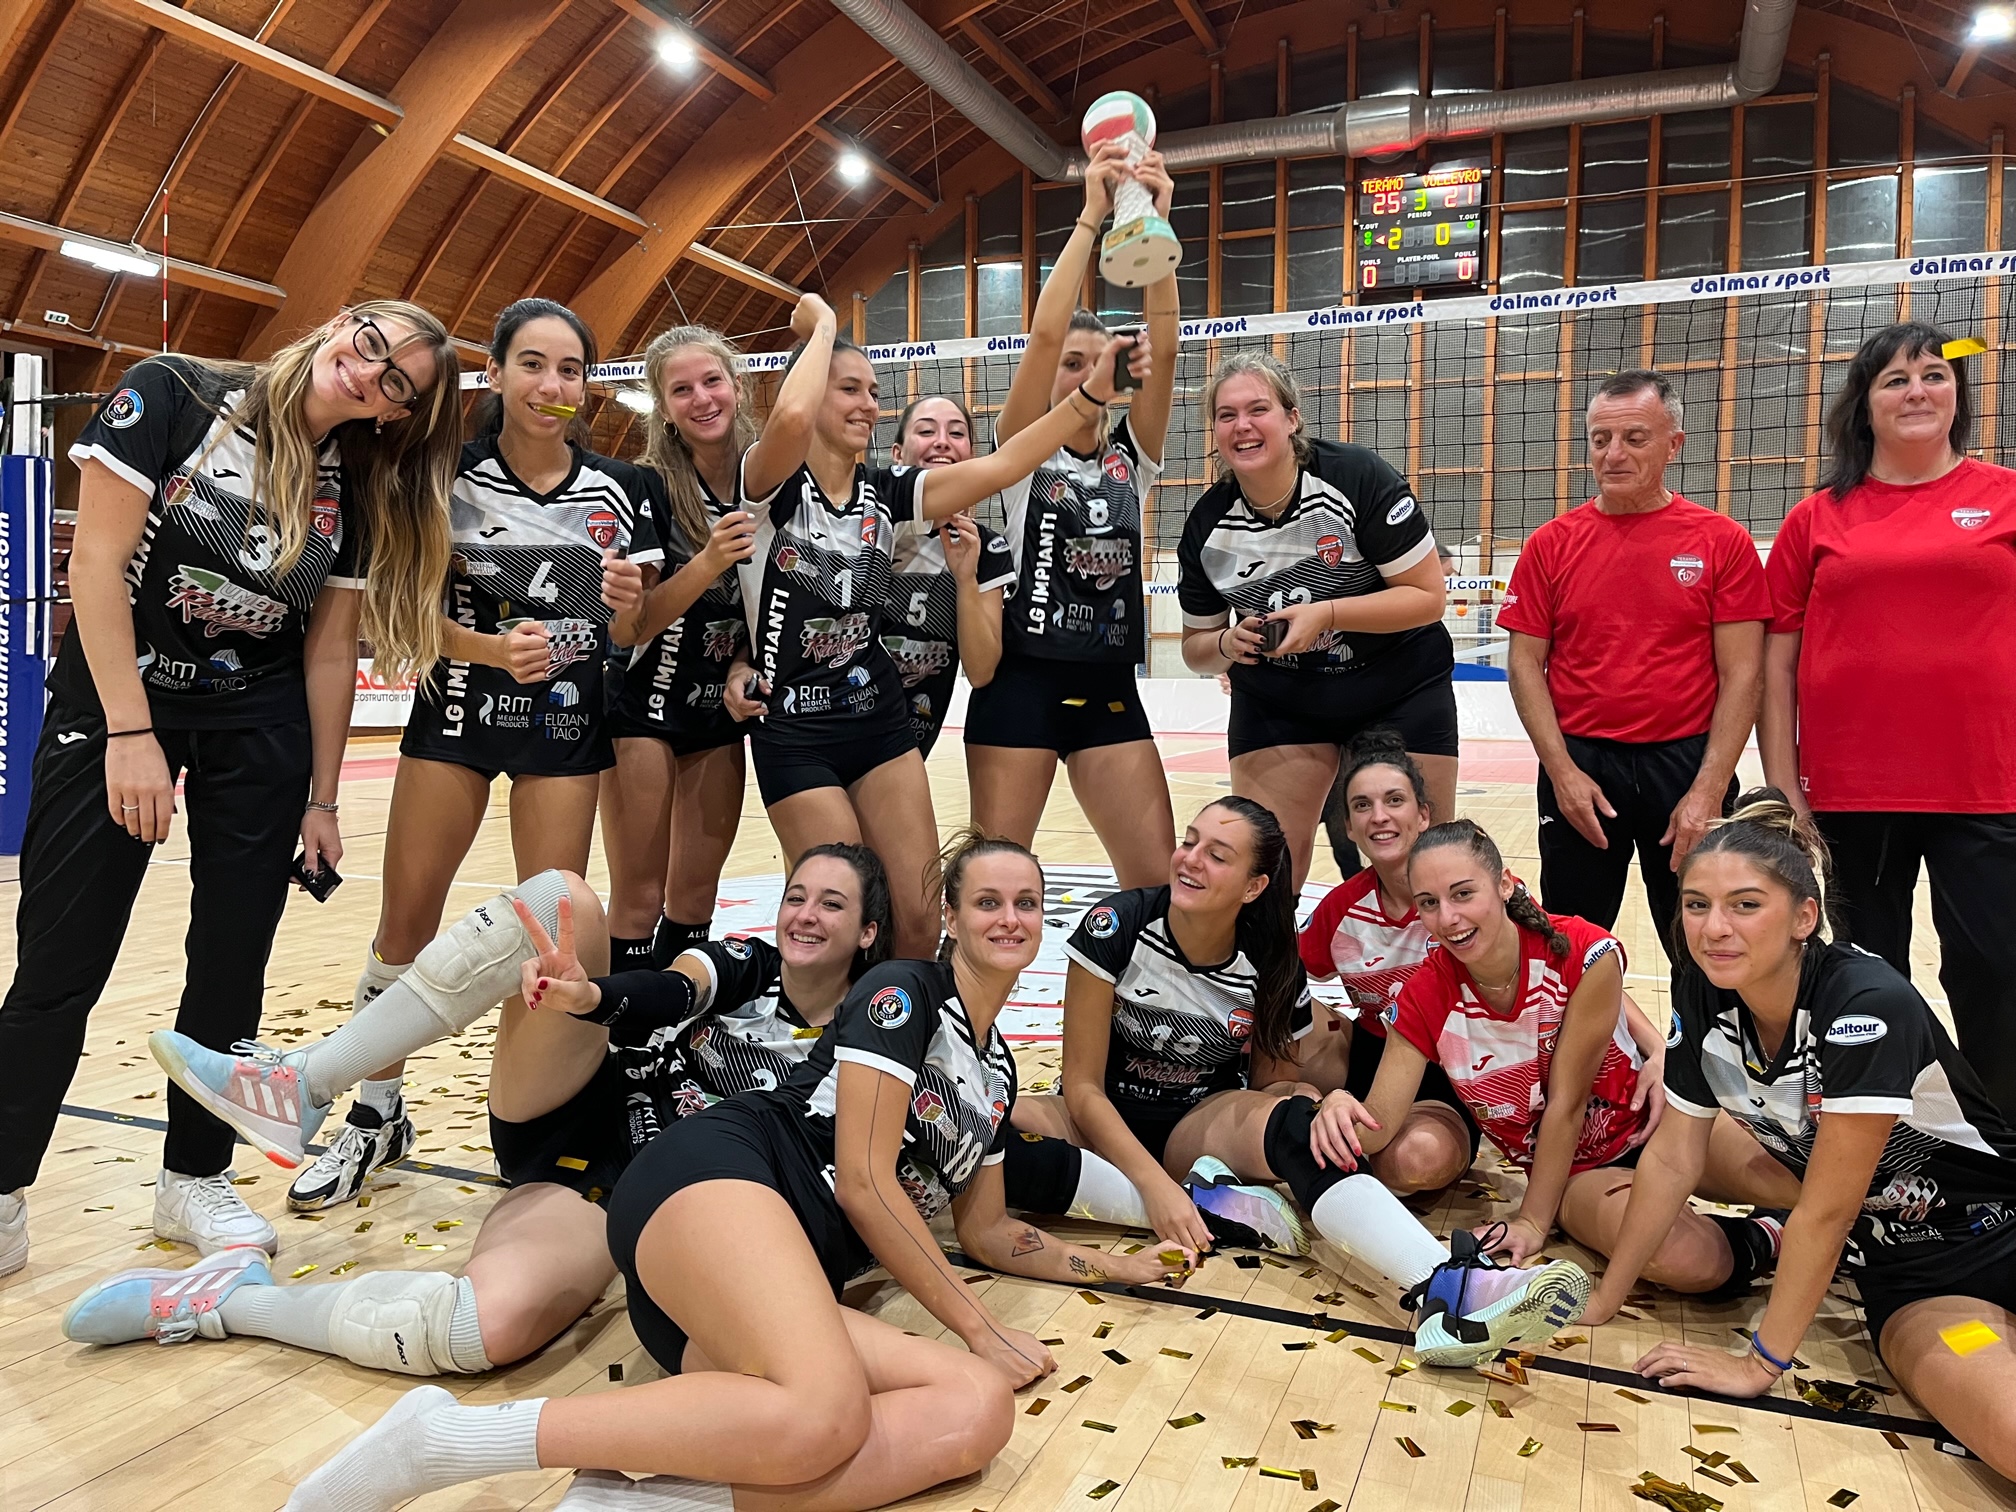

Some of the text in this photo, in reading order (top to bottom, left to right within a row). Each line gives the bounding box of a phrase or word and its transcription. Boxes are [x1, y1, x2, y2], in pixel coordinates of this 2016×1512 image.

[1361, 177, 1404, 194] TERAMO
[1372, 192, 1400, 215] 25
[1414, 188, 1428, 211] 3
[1444, 184, 1474, 208] 21
[1407, 211, 1432, 219] PERIOD
[1459, 213, 1479, 221] T.OUT
[1359, 222, 1379, 230] T.OUT
[1387, 223, 1450, 250] 2 0
[1360, 258, 1381, 266] FOULS
[1397, 253, 1440, 263] PLAYER-FOUL
[1454, 250, 1477, 258] FOULS
[1458, 258, 1473, 280] 0
[1909, 255, 1993, 276] dalmar
[1362, 265, 1377, 288] 0
[1690, 267, 1831, 294] dalmar sport
[1489, 286, 1617, 312] dalmar sport
[1307, 302, 1424, 327] dalmar sport
[1204, 317, 1248, 338] sport
[899, 342, 937, 361] sport
[987, 335, 1029, 351] dalm
[764, 355, 788, 370] spo
[1391, 500, 1412, 521] baltour
[239, 525, 280, 571] 3
[527, 561, 559, 603] 4
[1027, 512, 1058, 635] LG IMPIANTI
[834, 568, 853, 608] 1
[906, 592, 930, 627] 5
[545, 619, 588, 632] MBY
[763, 587, 790, 690] MPIANTI
[151, 670, 192, 688] MEDICAL
[647, 616, 686, 722] LG IMPIAN
[800, 699, 831, 707] MEDICAL
[801, 705, 832, 713] PRODUCTS
[442, 704, 466, 737] LG
[496, 714, 530, 722] MEDICAL
[496, 720, 530, 728] PRODUCTS
[625, 945, 652, 955] ALLS
[1829, 1023, 1880, 1036] baltour
[943, 1130, 983, 1184] 18
